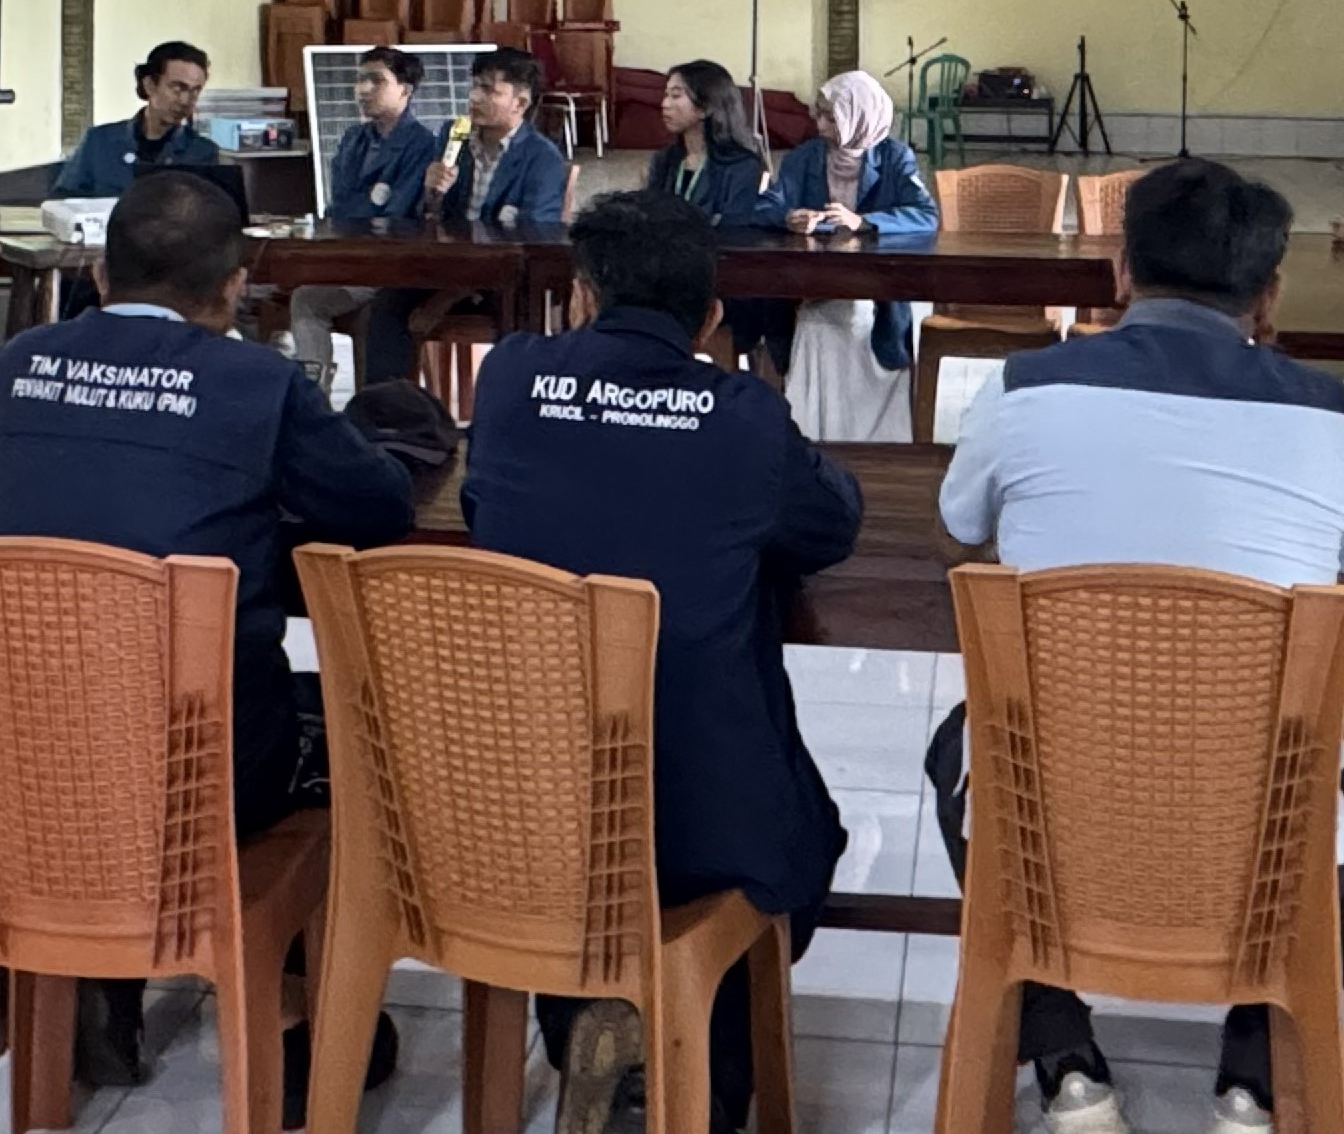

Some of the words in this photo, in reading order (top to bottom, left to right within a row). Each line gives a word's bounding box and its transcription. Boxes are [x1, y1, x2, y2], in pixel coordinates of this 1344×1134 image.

[29, 354, 62, 377] TIM
[66, 358, 194, 391] VAKSINATOR
[64, 383, 106, 408] MULUT
[117, 389, 156, 412] KUKU
[156, 392, 197, 418] (PMK)
[531, 374, 578, 401] KUD
[586, 378, 715, 414] ARGOPURO
[539, 403, 585, 422] KRUCIL
[601, 409, 700, 431] PROBOLINGGO
